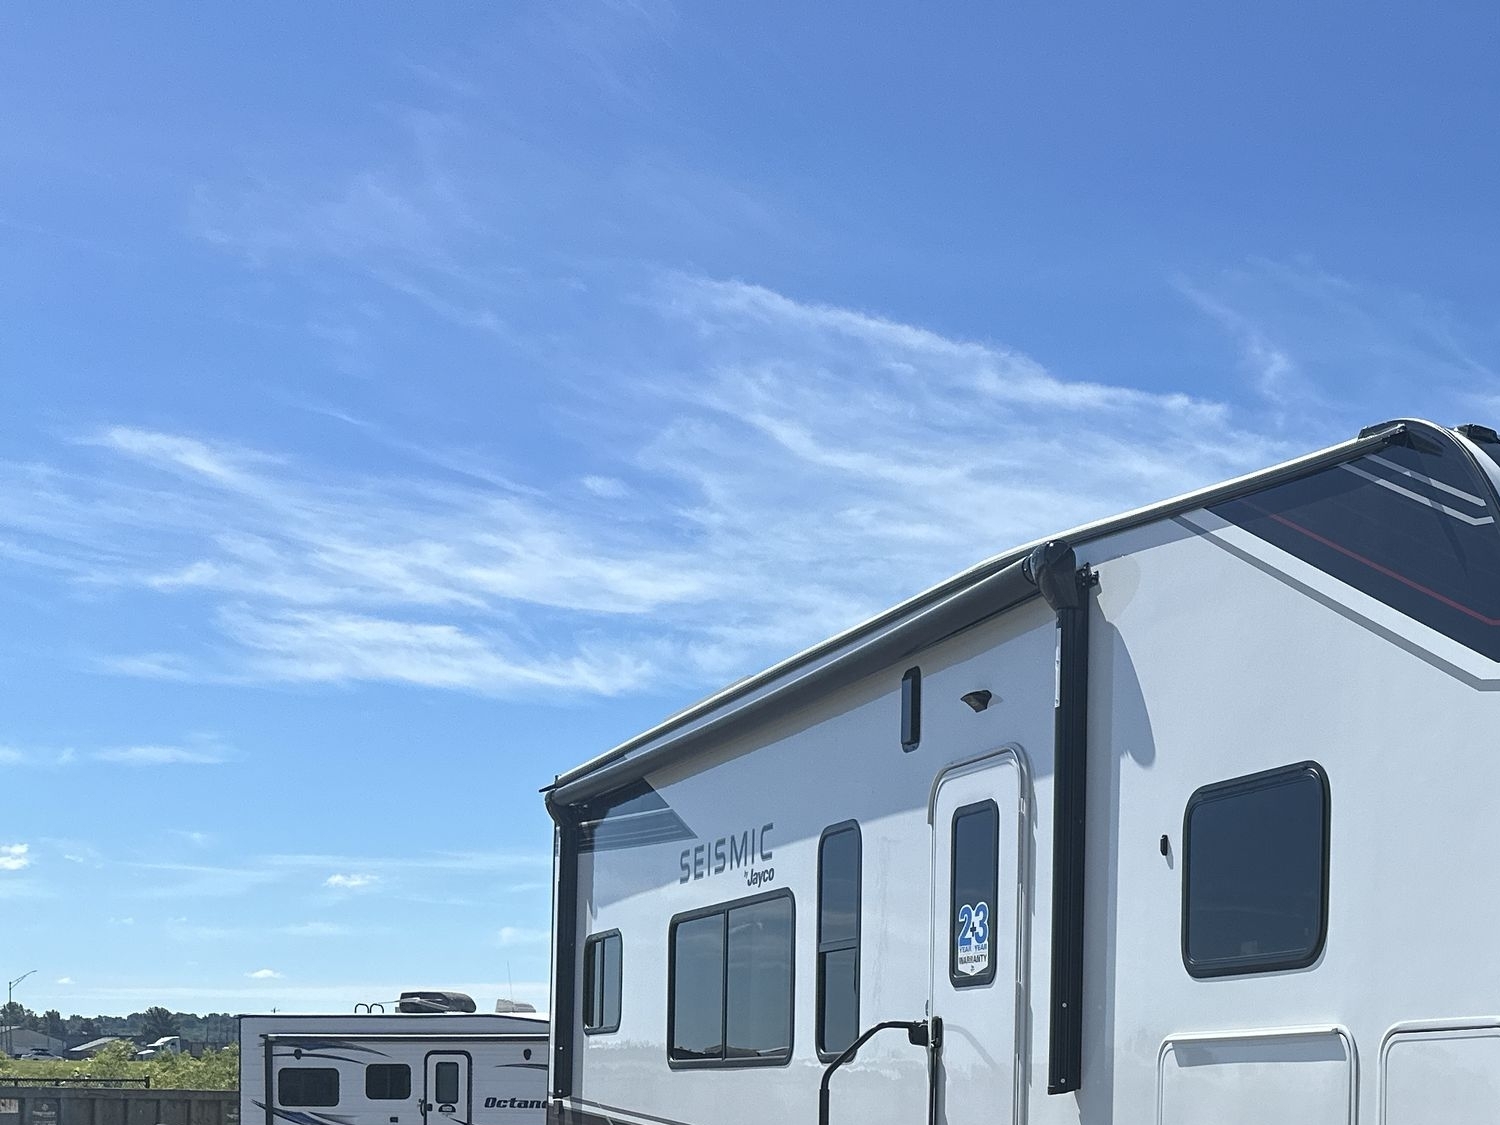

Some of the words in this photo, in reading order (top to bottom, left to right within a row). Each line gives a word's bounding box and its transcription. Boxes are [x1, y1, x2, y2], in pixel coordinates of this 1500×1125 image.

[680, 822, 774, 885] SEISMIC
[747, 867, 775, 888] Jayco
[959, 954, 987, 965] WARRANTY
